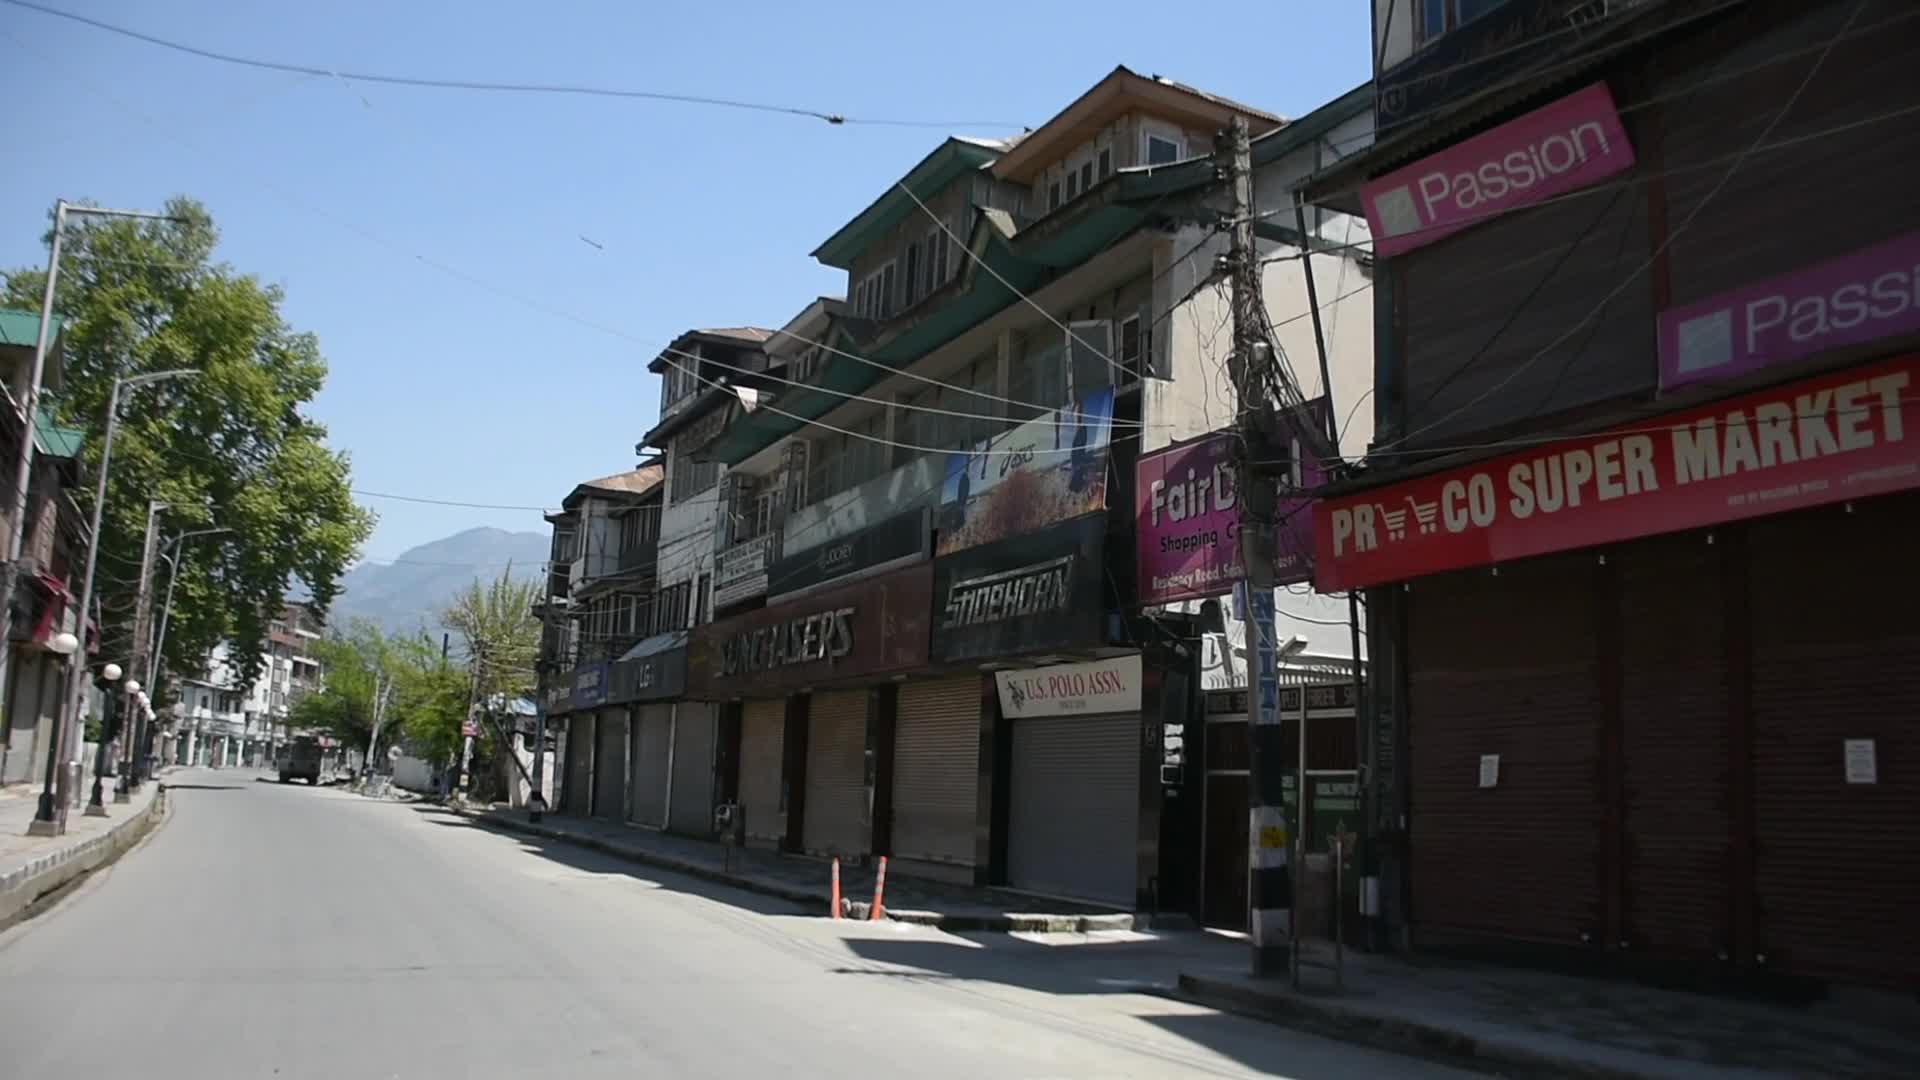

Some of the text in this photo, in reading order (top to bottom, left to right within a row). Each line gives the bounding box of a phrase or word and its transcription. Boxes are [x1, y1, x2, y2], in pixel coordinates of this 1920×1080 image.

[1418, 119, 1612, 220] Passion
[1508, 434, 1660, 520] SUPER
[1670, 371, 1911, 486] MARKET
[1160, 528, 1218, 552] Shopping
[1025, 669, 1127, 701] U.S. POLO ASSN.
